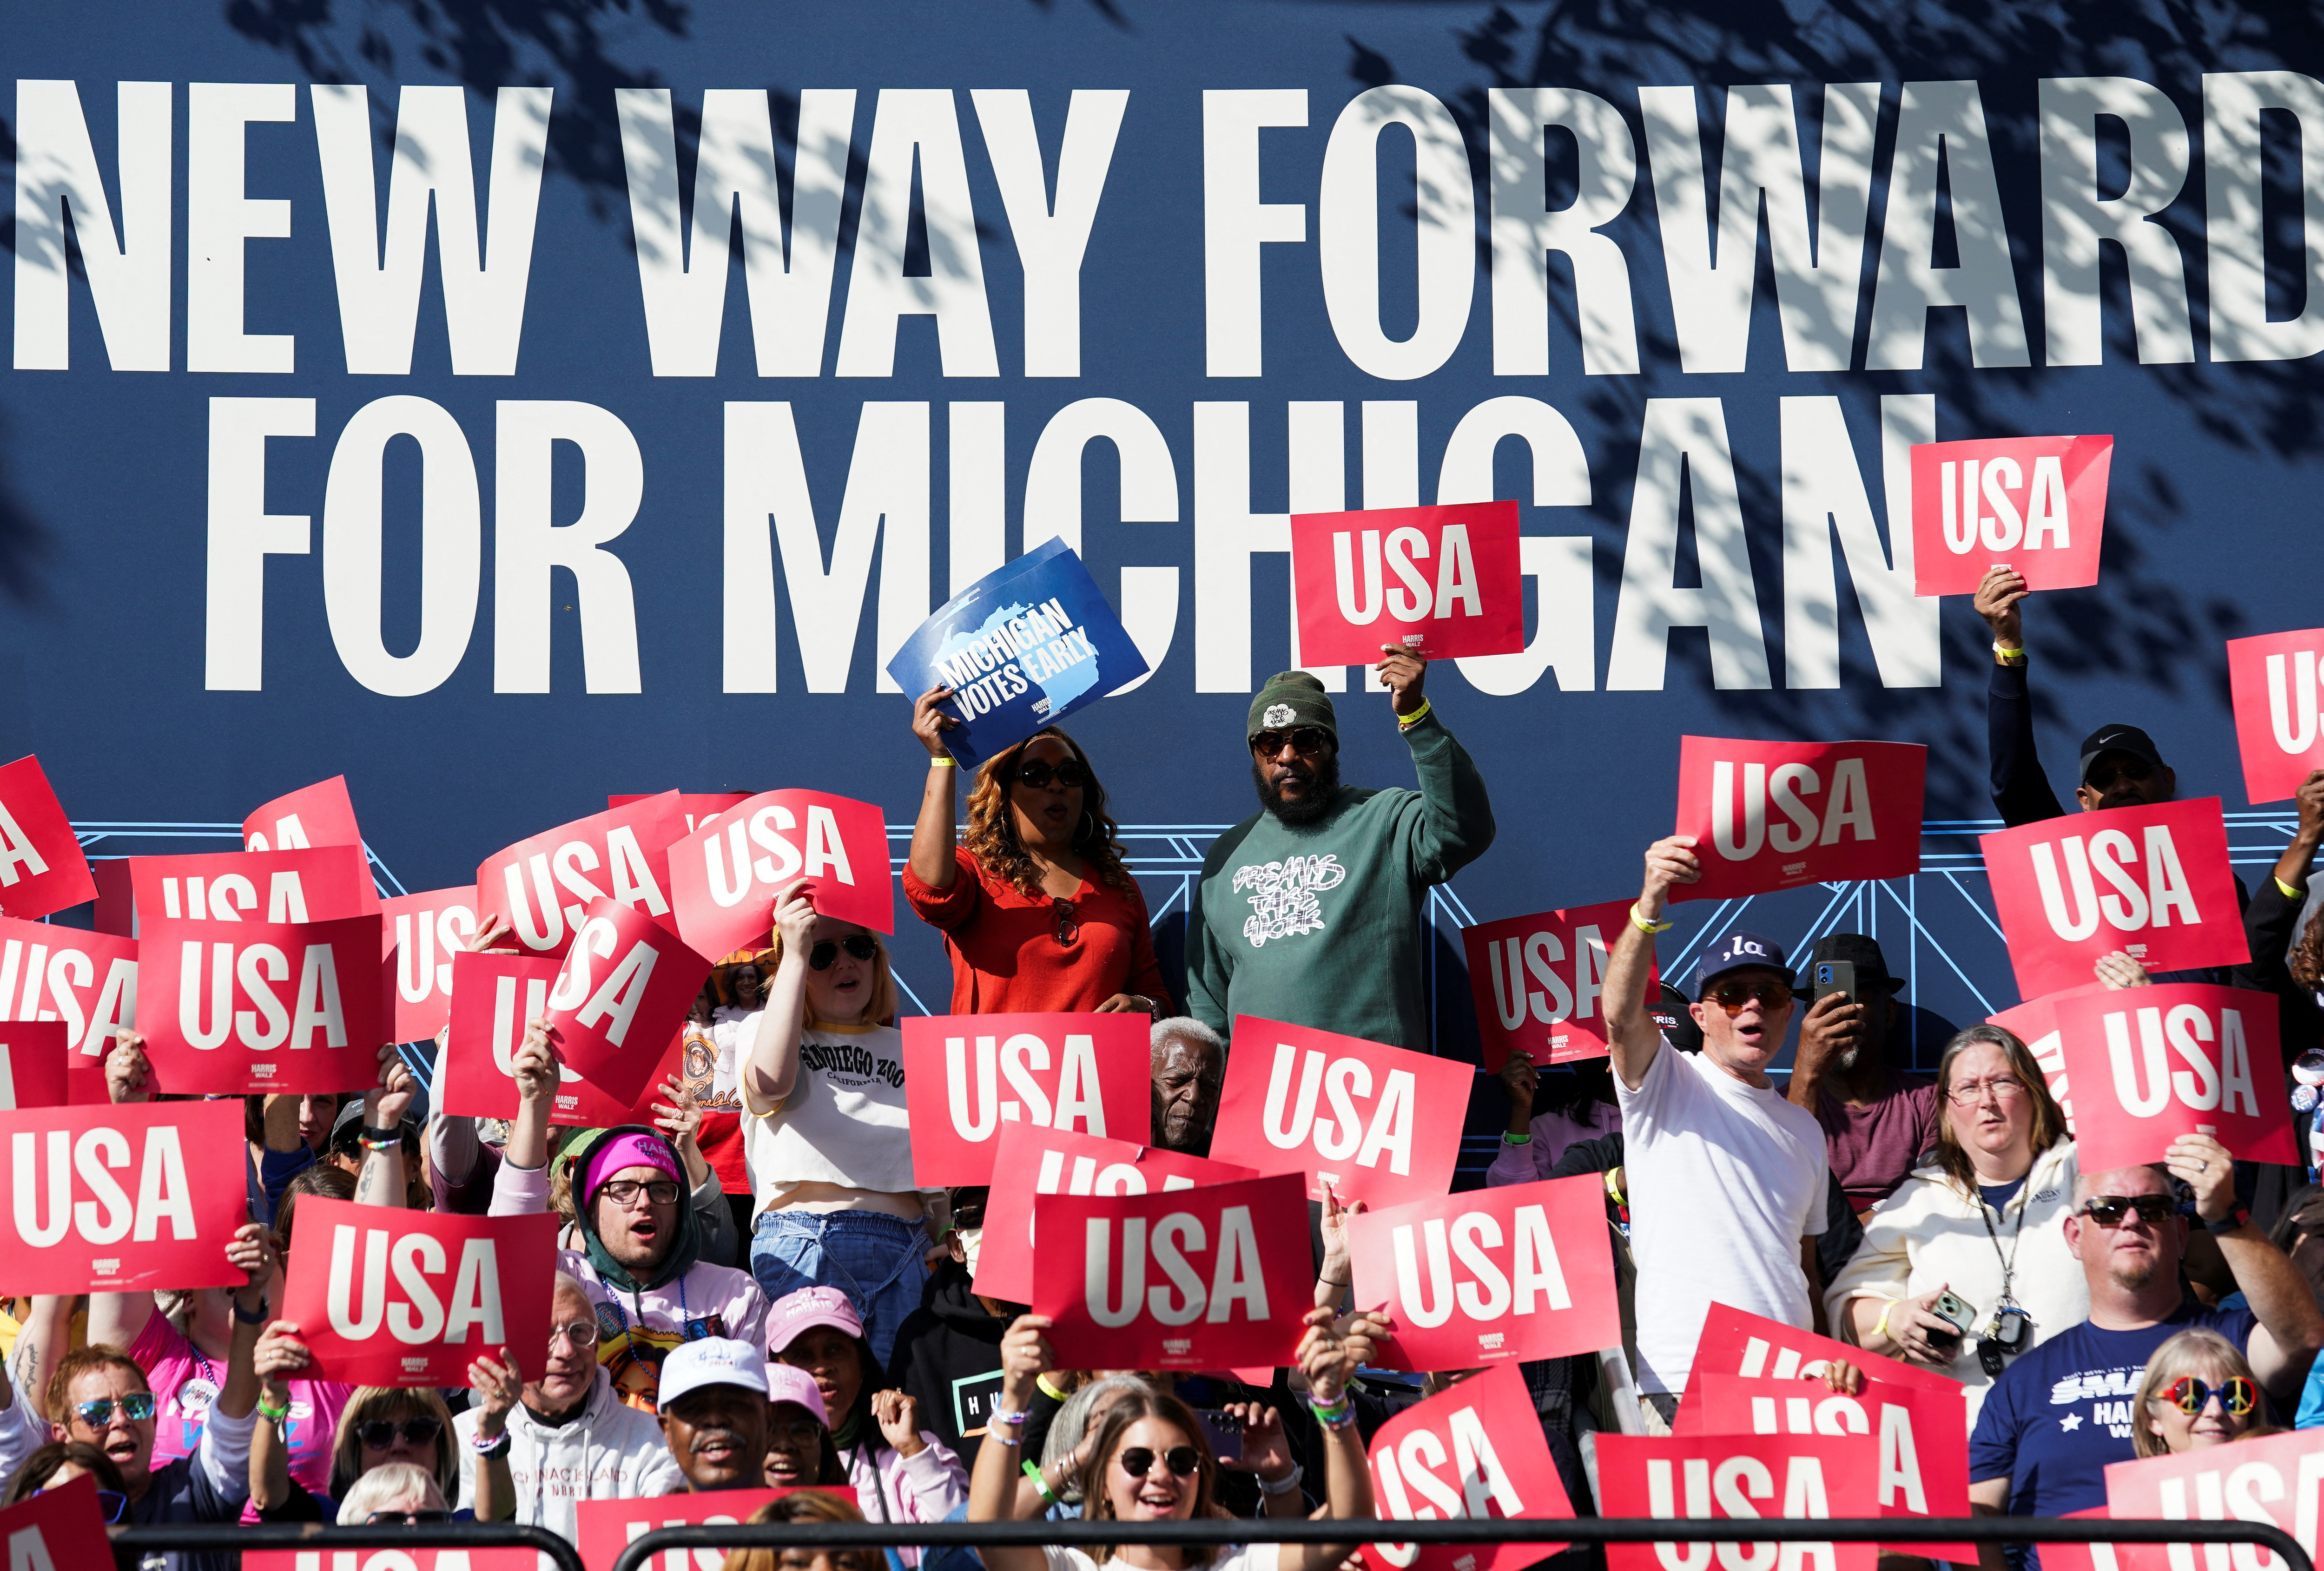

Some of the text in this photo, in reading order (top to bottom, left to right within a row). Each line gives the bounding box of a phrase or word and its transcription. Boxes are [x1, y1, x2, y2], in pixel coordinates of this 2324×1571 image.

[13, 71, 2324, 381] NEW WAY FORWARD
[205, 393, 1941, 697] FOR MICHIGAN
[1941, 456, 2070, 554] USA
[1333, 524, 1483, 625] USA
[936, 597, 1073, 690] MICHIGAN
[951, 625, 1095, 722] VOTES EARLY
[1402, 634, 1423, 643] HARRIS
[1031, 697, 1052, 712] HARRIS
[1038, 704, 1052, 714] WALZ
[704, 805, 855, 907] USA
[1712, 758, 1876, 861] USA
[504, 825, 670, 951] USA
[1782, 861, 1806, 871] HARRIS
[2029, 825, 2202, 942] USA
[0, 939, 138, 1057] USA
[179, 941, 348, 1051] USA
[396, 905, 476, 1004] US
[1489, 924, 1609, 1031] USA
[251, 1064, 277, 1073] HARRIS
[820, 1045, 873, 1077] DIEGO
[877, 1058, 905, 1088] ZOO
[1548, 1035, 1569, 1045] HARRIS
[1652, 1016, 1679, 1025] RIS.
[2103, 1004, 2260, 1118] USA
[555, 1095, 578, 1105] HARRIS
[945, 1033, 1107, 1142] USA
[1263, 1043, 1415, 1177] USA
[13, 1125, 197, 1248] USA
[1317, 1170, 1340, 1184] HARRIS
[327, 1224, 506, 1345] USA
[1085, 1205, 1270, 1328] USA
[1393, 1204, 1572, 1328] USA
[1478, 1332, 1505, 1344] HARRIS
[1647, 1455, 1836, 1571] USA
